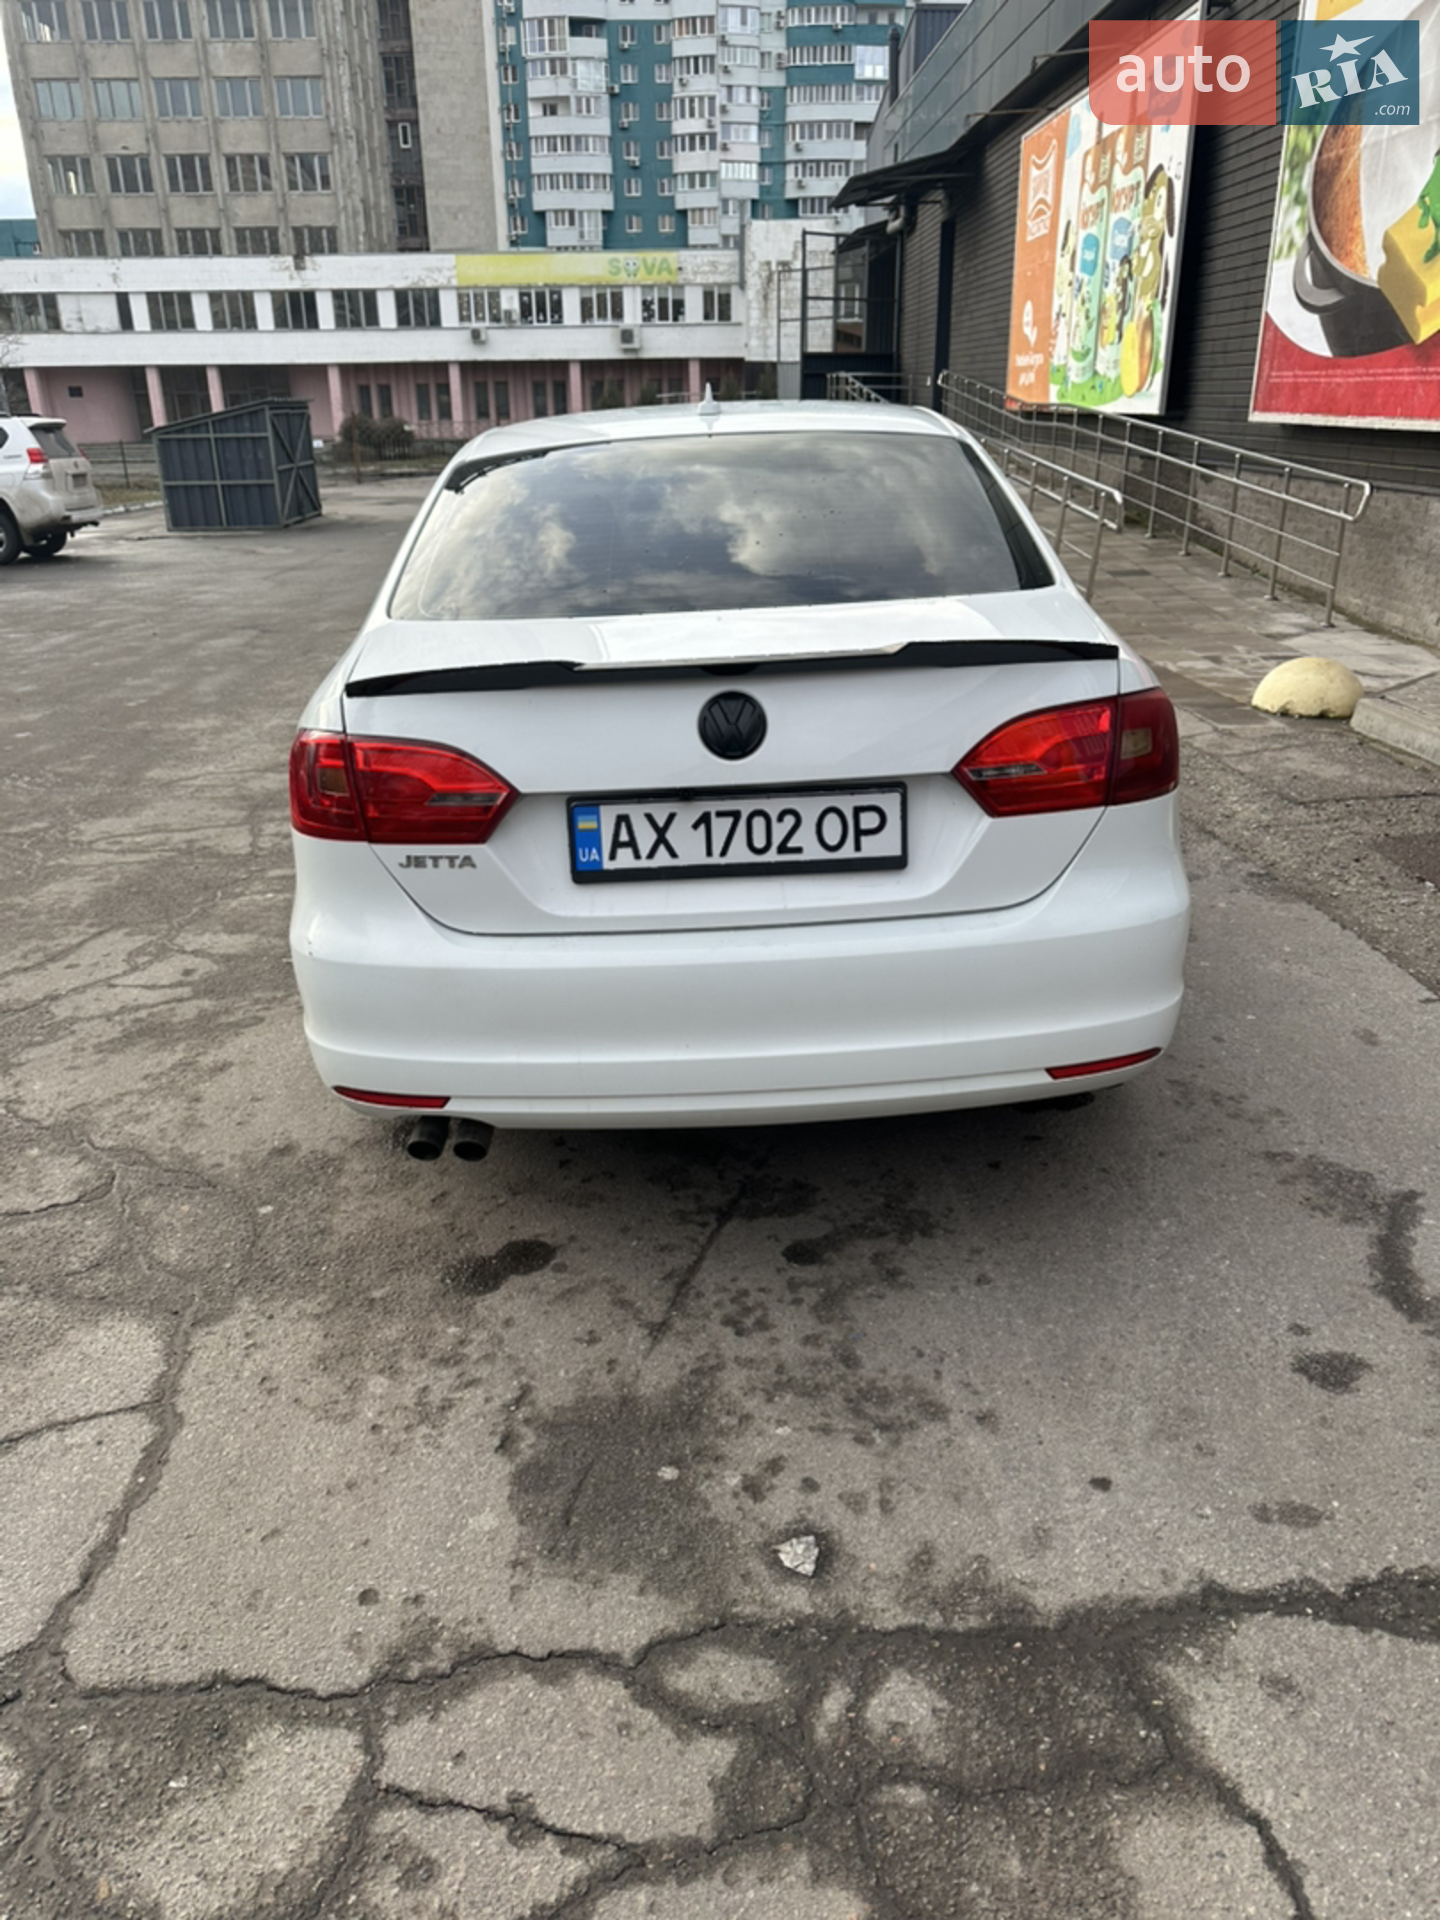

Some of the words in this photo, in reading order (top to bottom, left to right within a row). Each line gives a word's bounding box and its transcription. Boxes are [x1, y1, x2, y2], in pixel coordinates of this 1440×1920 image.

[608, 257, 673, 277] SOVA
[608, 813, 679, 861] AX
[691, 808, 804, 859] 1702
[815, 805, 888, 854] OP
[398, 855, 477, 869] JETTA
[579, 848, 600, 863] UA
